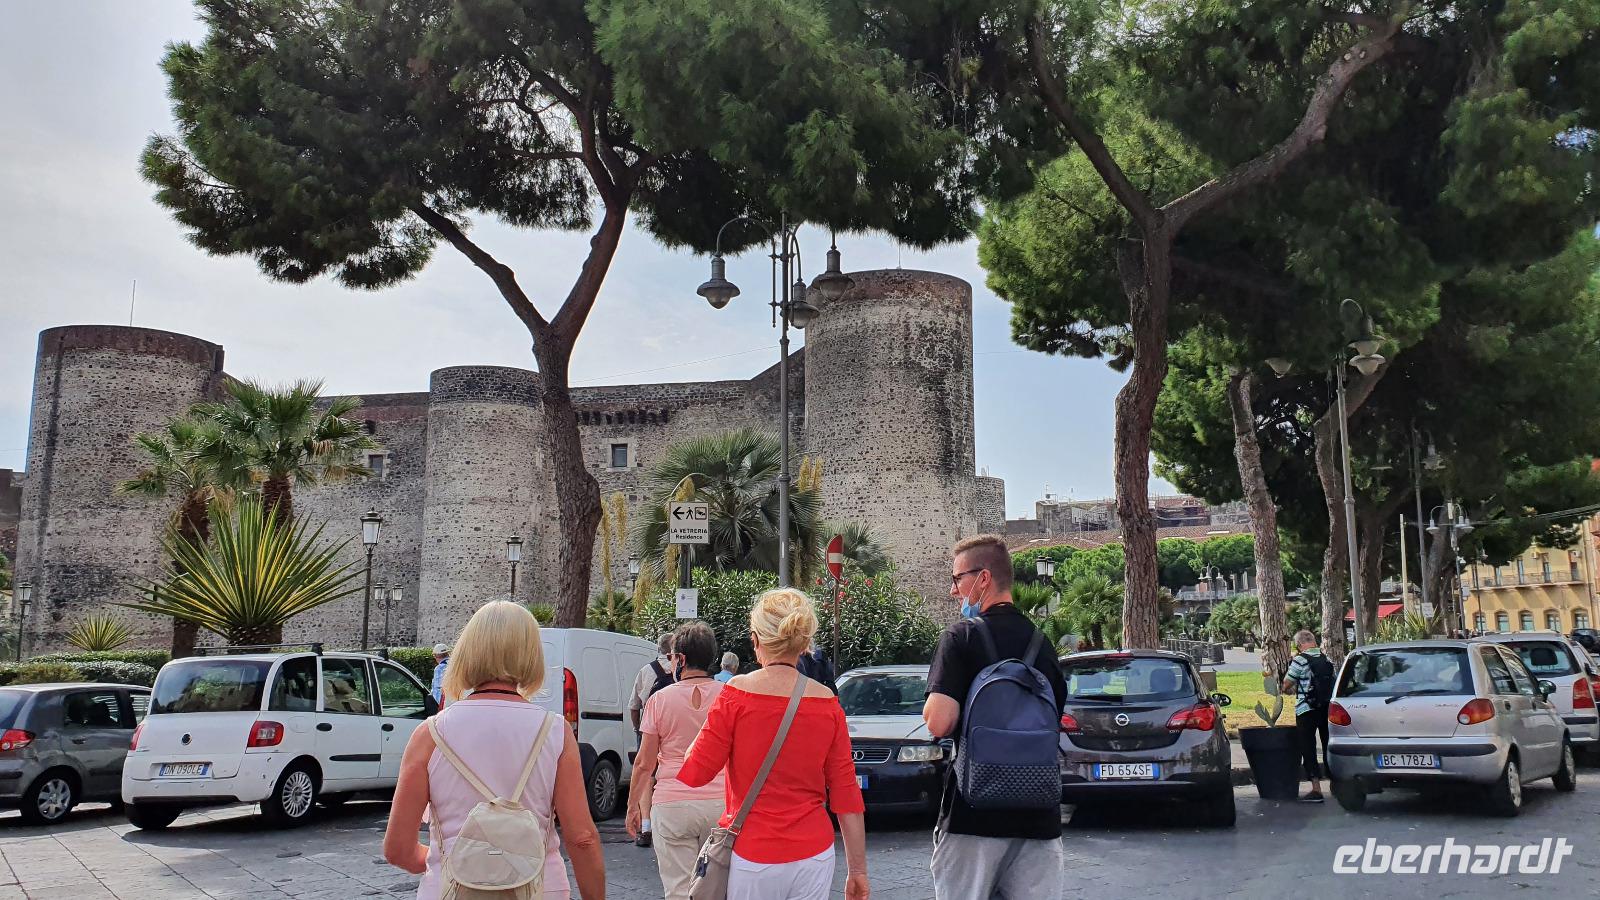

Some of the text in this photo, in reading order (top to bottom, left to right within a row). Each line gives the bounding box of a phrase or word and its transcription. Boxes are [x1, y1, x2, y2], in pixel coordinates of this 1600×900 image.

[1383, 754, 1433, 766] BC 178ZJ
[1101, 764, 1152, 776] FD 654SF
